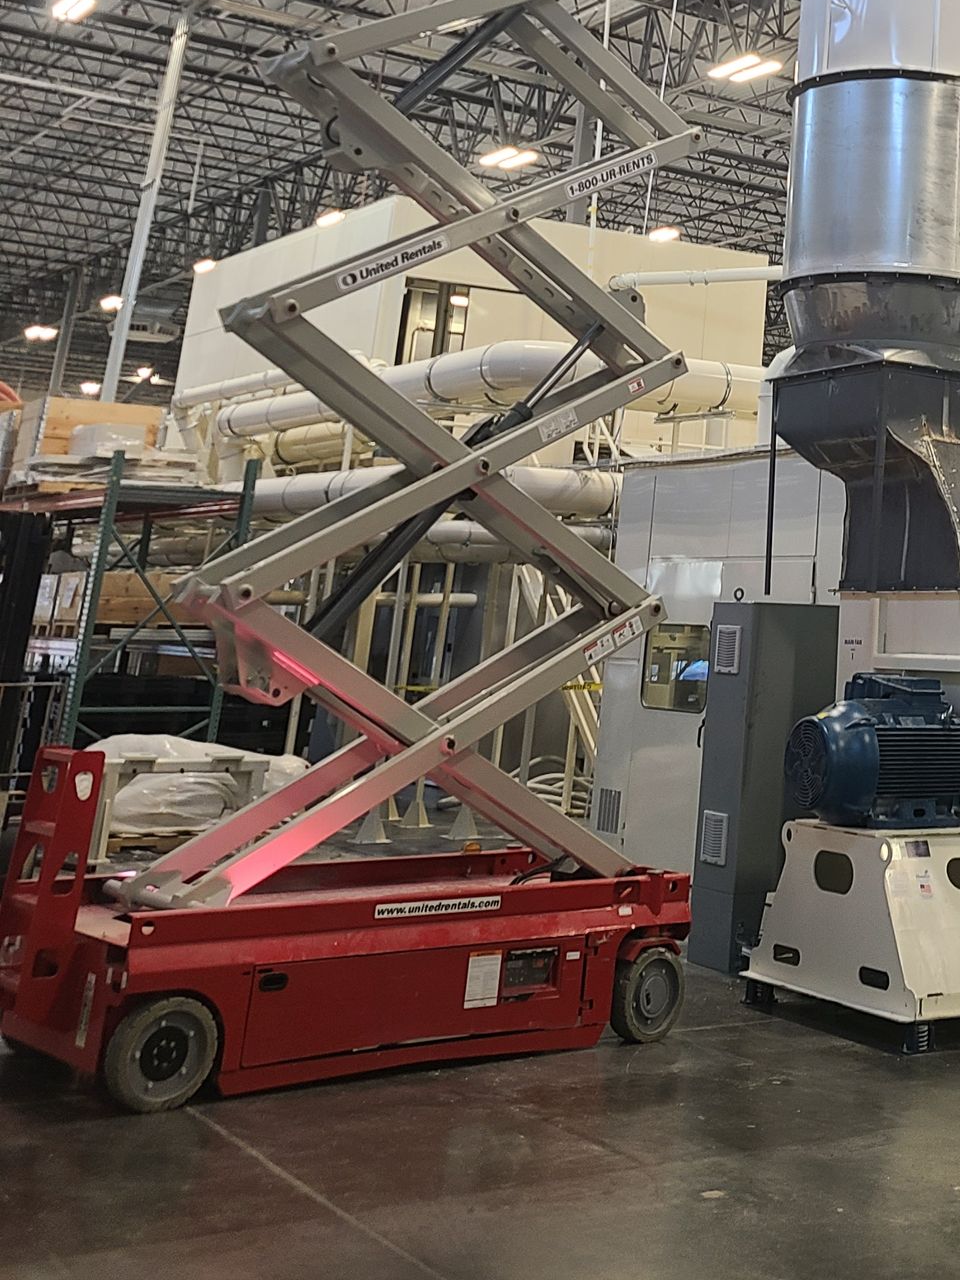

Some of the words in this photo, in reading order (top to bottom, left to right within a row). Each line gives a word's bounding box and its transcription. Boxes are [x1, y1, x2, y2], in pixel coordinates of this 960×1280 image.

[359, 256, 399, 280] United
[401, 240, 443, 264] Rentals
[377, 899, 500, 916] www.unitedrentals.com
